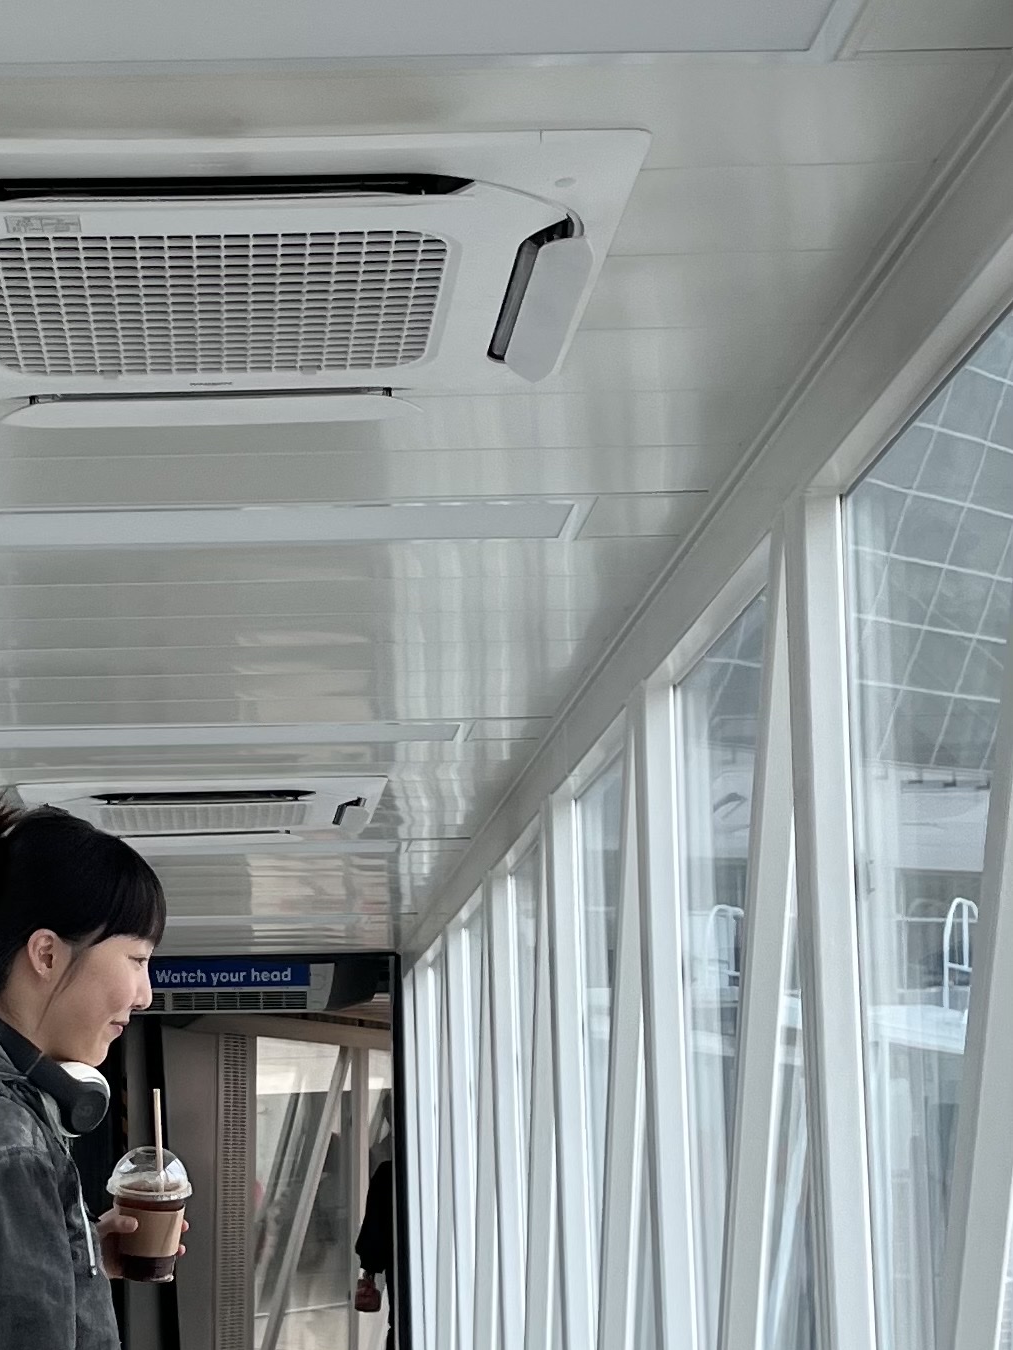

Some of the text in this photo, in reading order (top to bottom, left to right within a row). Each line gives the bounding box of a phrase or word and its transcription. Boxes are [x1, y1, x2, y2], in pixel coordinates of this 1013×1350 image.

[155, 967, 292, 986] Watch your head
